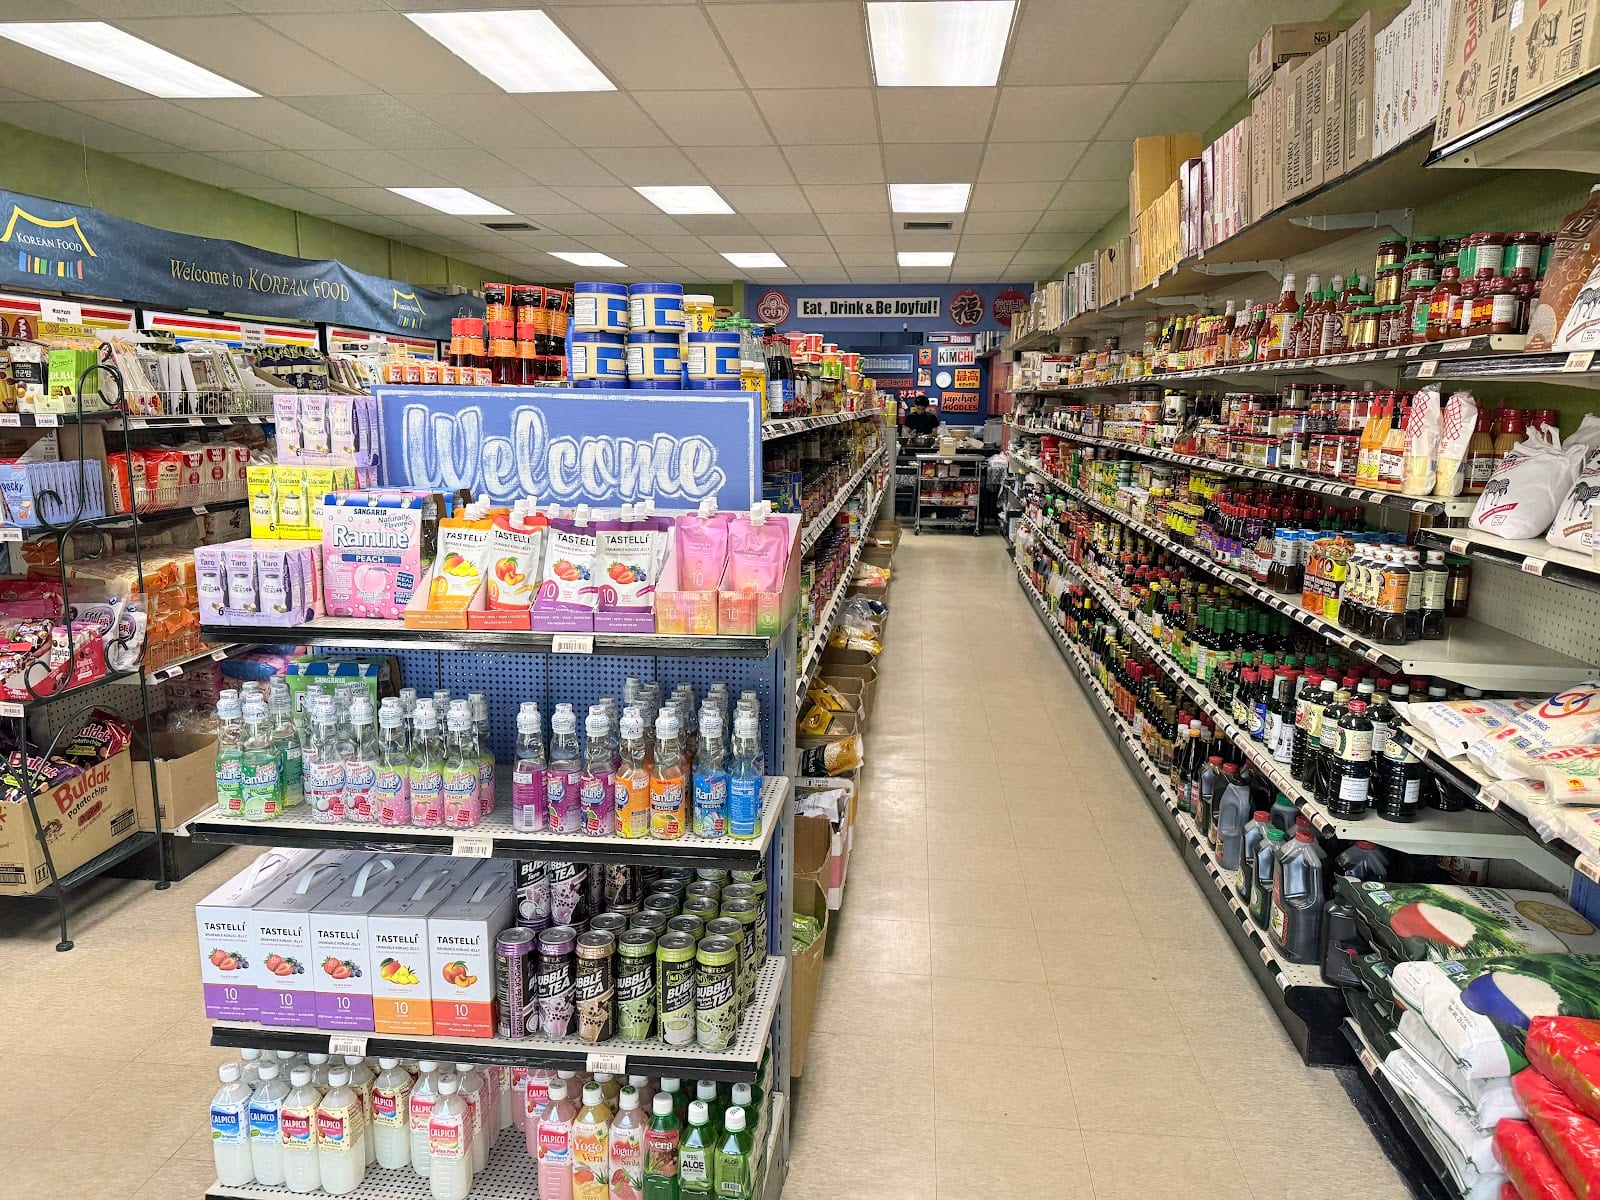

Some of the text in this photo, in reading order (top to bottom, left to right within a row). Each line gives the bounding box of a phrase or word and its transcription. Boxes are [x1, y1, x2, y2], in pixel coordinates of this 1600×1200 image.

[1351, 32, 1359, 87] ICHIBAN
[1358, 25, 1366, 85] SAPPORO
[1306, 66, 1314, 120] ICHIBAN
[1314, 60, 1322, 115] SAPPORO
[1325, 117, 1333, 171] SAPPORO
[1293, 138, 1301, 188] ICHIBAN
[16, 232, 82, 252] KOREAN FOOD
[170, 259, 350, 302] Welcome to KOREAN FOOD
[830, 300, 864, 315] Drink
[865, 303, 875, 315] &
[876, 301, 891, 315] Be
[894, 300, 938, 315] Joyful!
[951, 295, 982, 325] 福
[939, 351, 974, 364] KIMCHI
[956, 370, 979, 382] 最高
[402, 403, 727, 502] Welcome
[353, 508, 387, 516] SANGARIA
[378, 513, 410, 524] Naturally
[269, 522, 275, 531] 6
[384, 519, 413, 528] Flavored
[332, 523, 409, 549] Ramuné
[557, 533, 596, 547] TASTELL
[355, 555, 385, 563] PEACH
[544, 583, 556, 598] 10
[602, 588, 615, 603] 10
[218, 606, 224, 616] 6
[51, 763, 111, 815] Buldak
[555, 865, 576, 881] TEA
[538, 965, 569, 986] UBBLE
[548, 975, 570, 997] TEA
[582, 981, 604, 999] TEA
[631, 978, 652, 998] TEA
[224, 987, 238, 1001] 10
[279, 993, 293, 1006] 10
[712, 989, 734, 1008] TEA
[336, 996, 350, 1009] 10
[394, 1001, 409, 1014] 10
[454, 1003, 468, 1016] 10
[412, 1105, 434, 1114] CALPIC
[212, 1114, 236, 1124] CALPICO
[251, 1112, 275, 1122] CALPICO
[282, 1119, 307, 1129] CALPICO
[318, 1118, 340, 1129] CALPICO
[430, 1128, 456, 1138] CALPICO
[540, 1134, 565, 1144] CALPICO
[574, 1139, 603, 1154] Yogo
[582, 1154, 603, 1162] Vera
[682, 1161, 704, 1170] ALOE
